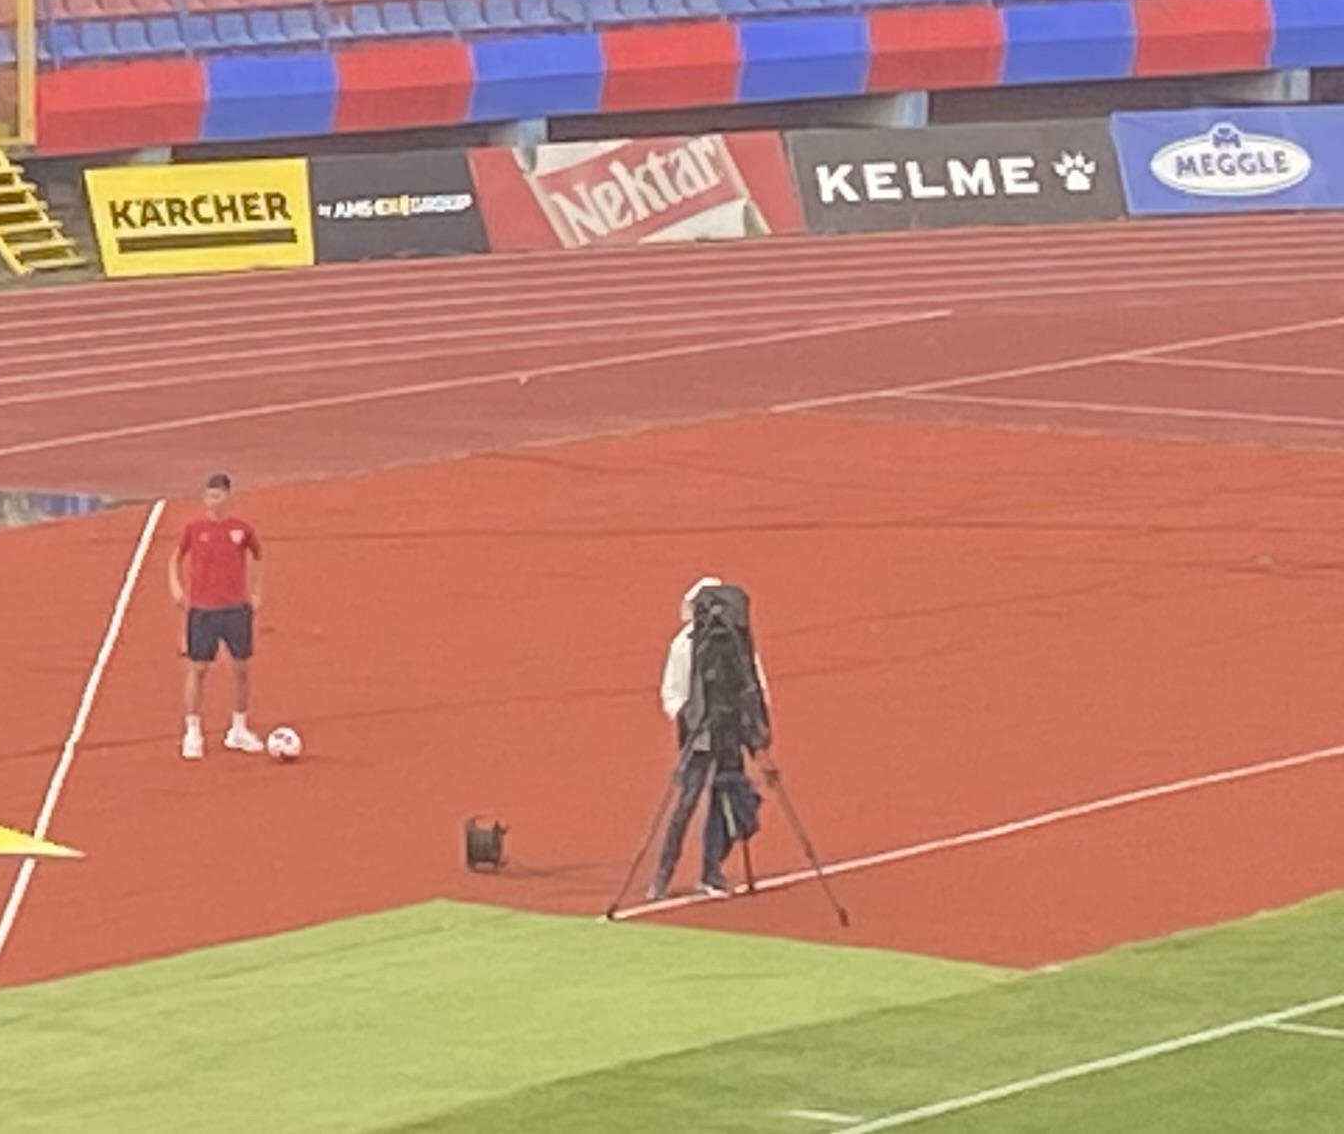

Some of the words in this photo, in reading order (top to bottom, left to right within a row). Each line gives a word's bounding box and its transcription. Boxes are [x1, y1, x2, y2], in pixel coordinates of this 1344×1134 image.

[815, 156, 1040, 205] KELME
[1175, 151, 1290, 178] MEGGLE
[108, 190, 291, 230] KÄRCHER
[550, 134, 724, 246] Nektar
